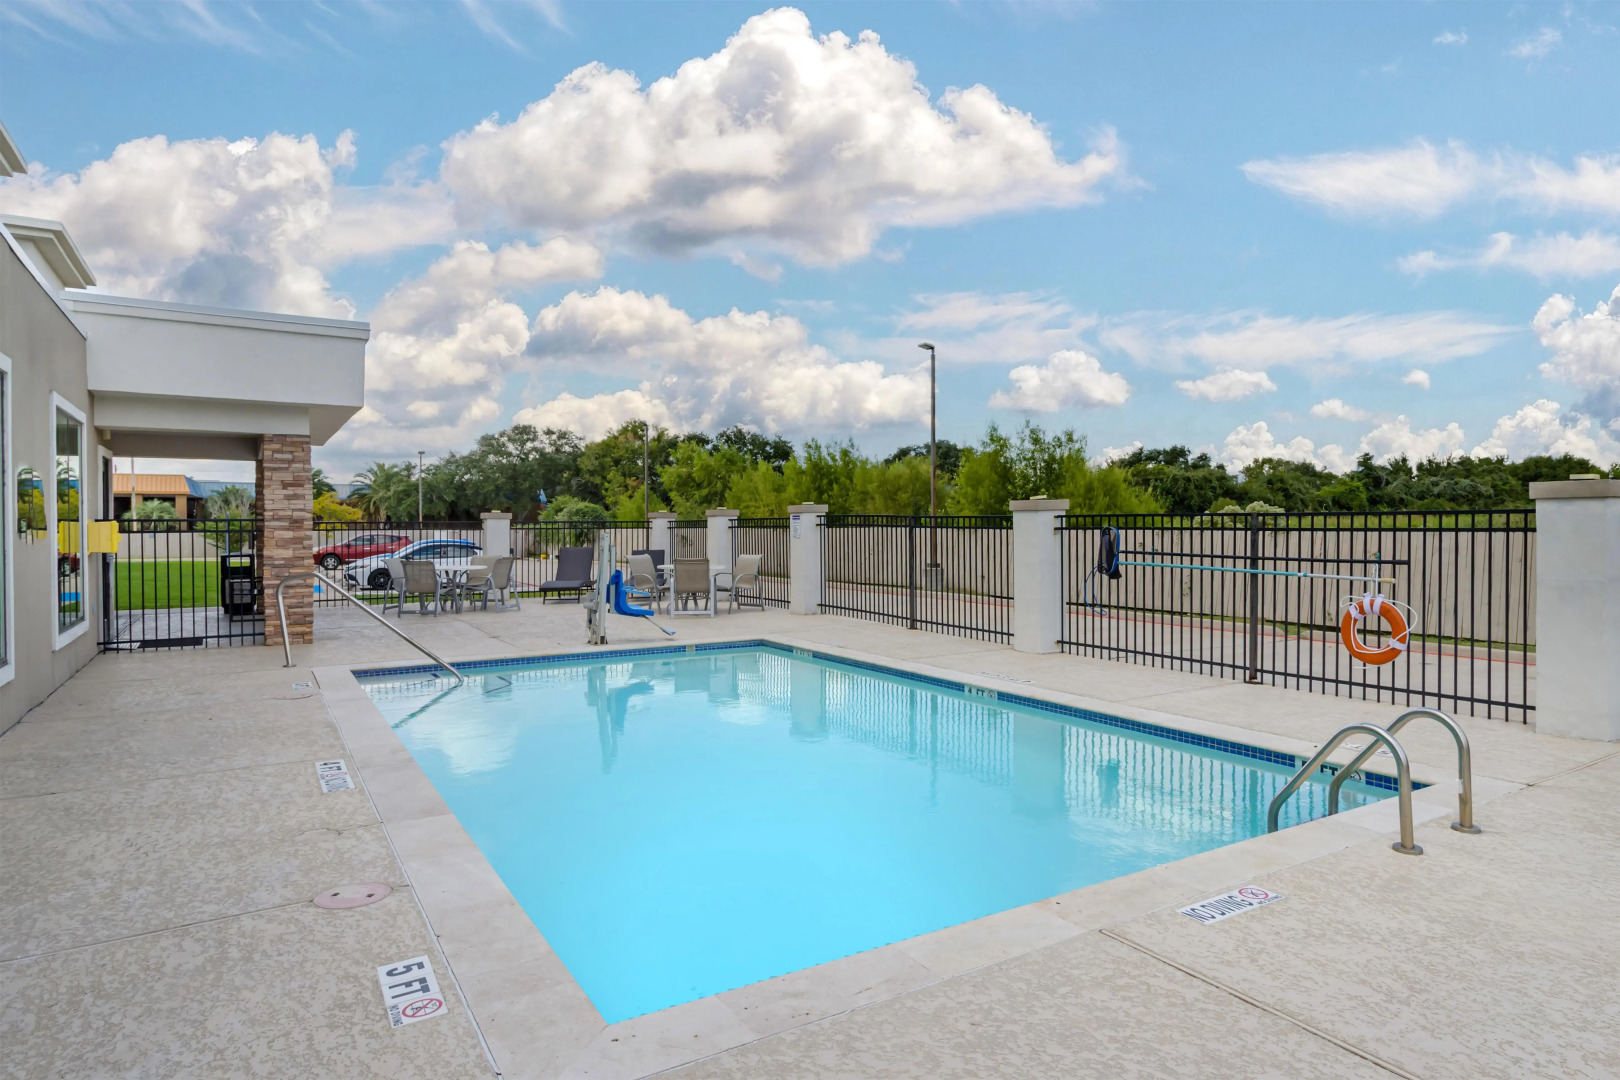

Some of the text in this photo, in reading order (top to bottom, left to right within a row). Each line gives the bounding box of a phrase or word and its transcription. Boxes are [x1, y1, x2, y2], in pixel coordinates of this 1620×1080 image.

[976, 688, 986, 696] FT
[1320, 764, 1338, 776] FT
[1181, 895, 1254, 922] NO DIVING
[385, 961, 431, 1000] 5 FT
